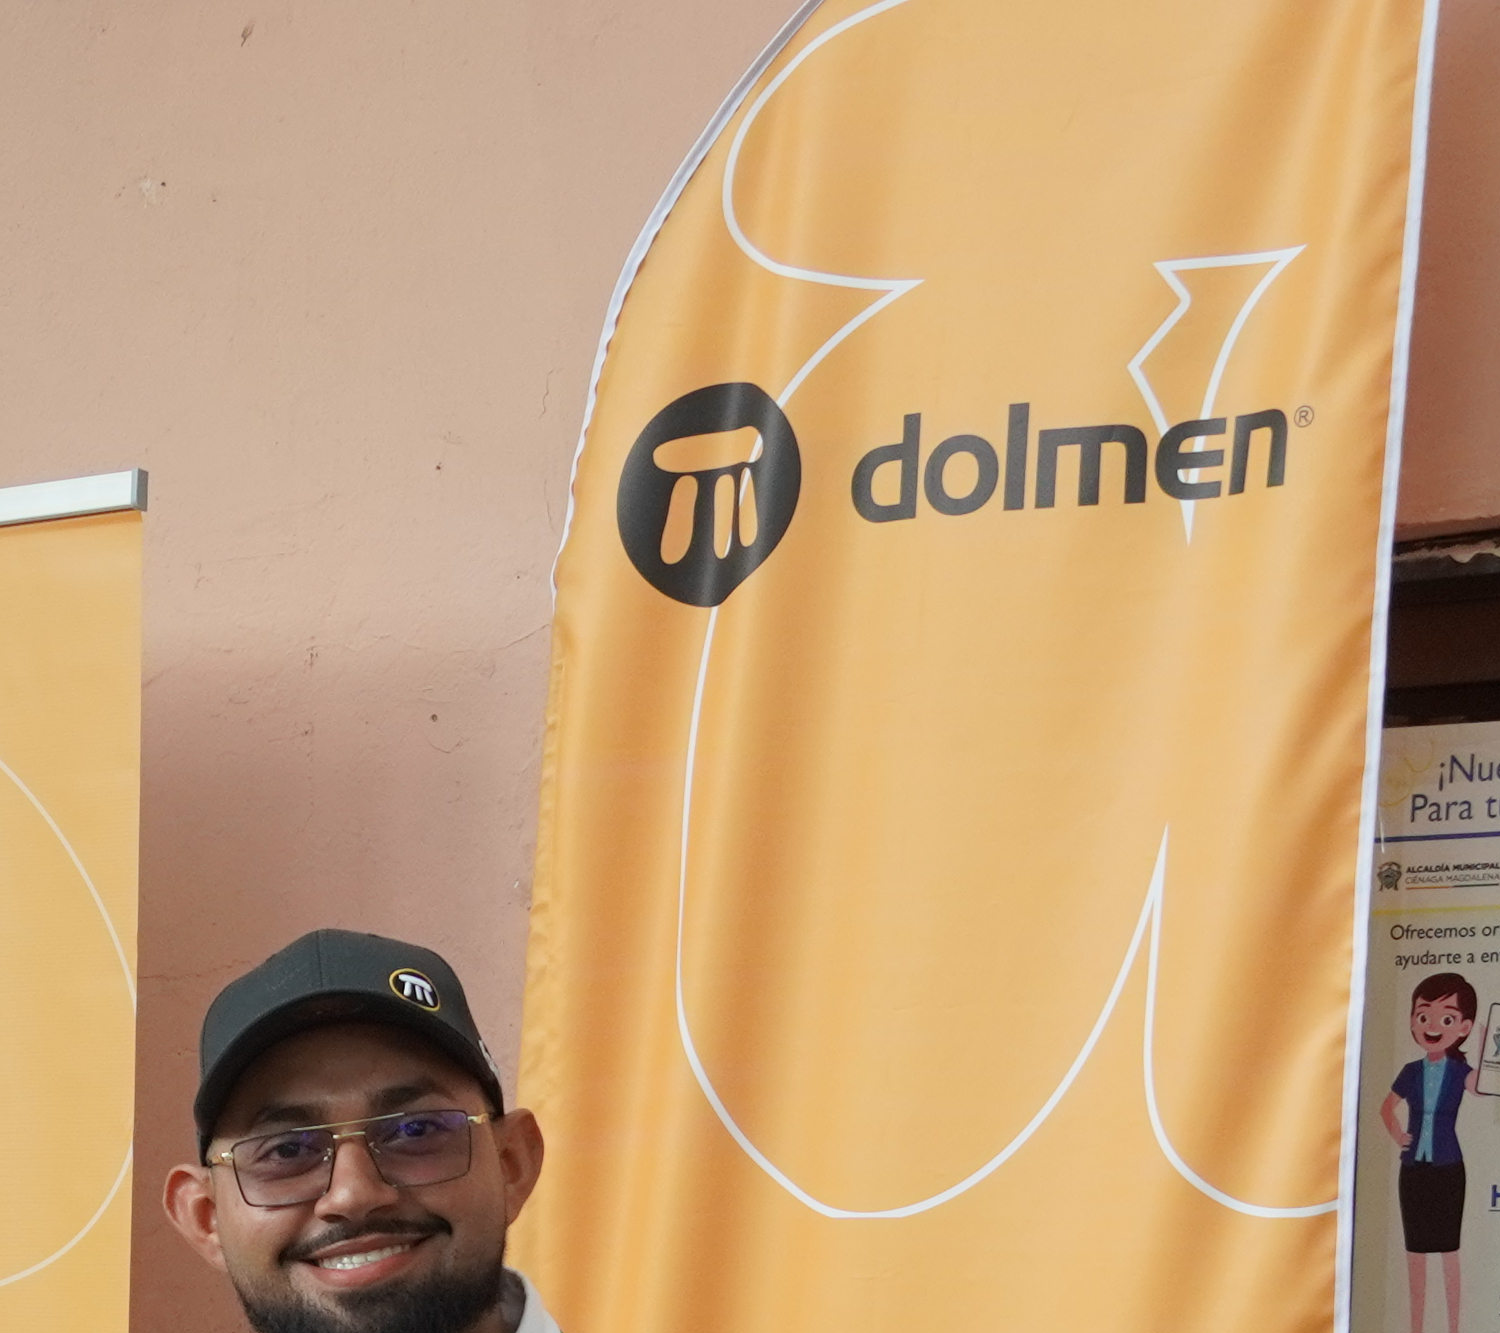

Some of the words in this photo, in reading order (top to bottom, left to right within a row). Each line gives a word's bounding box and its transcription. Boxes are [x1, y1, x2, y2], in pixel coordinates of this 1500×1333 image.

[1410, 793, 1474, 823] Para
[1406, 863, 1451, 873] ALCALDÍA
[1390, 924, 1476, 940] Ofrecemos
[1395, 950, 1462, 970] ayudarte
[1466, 953, 1475, 963] a
